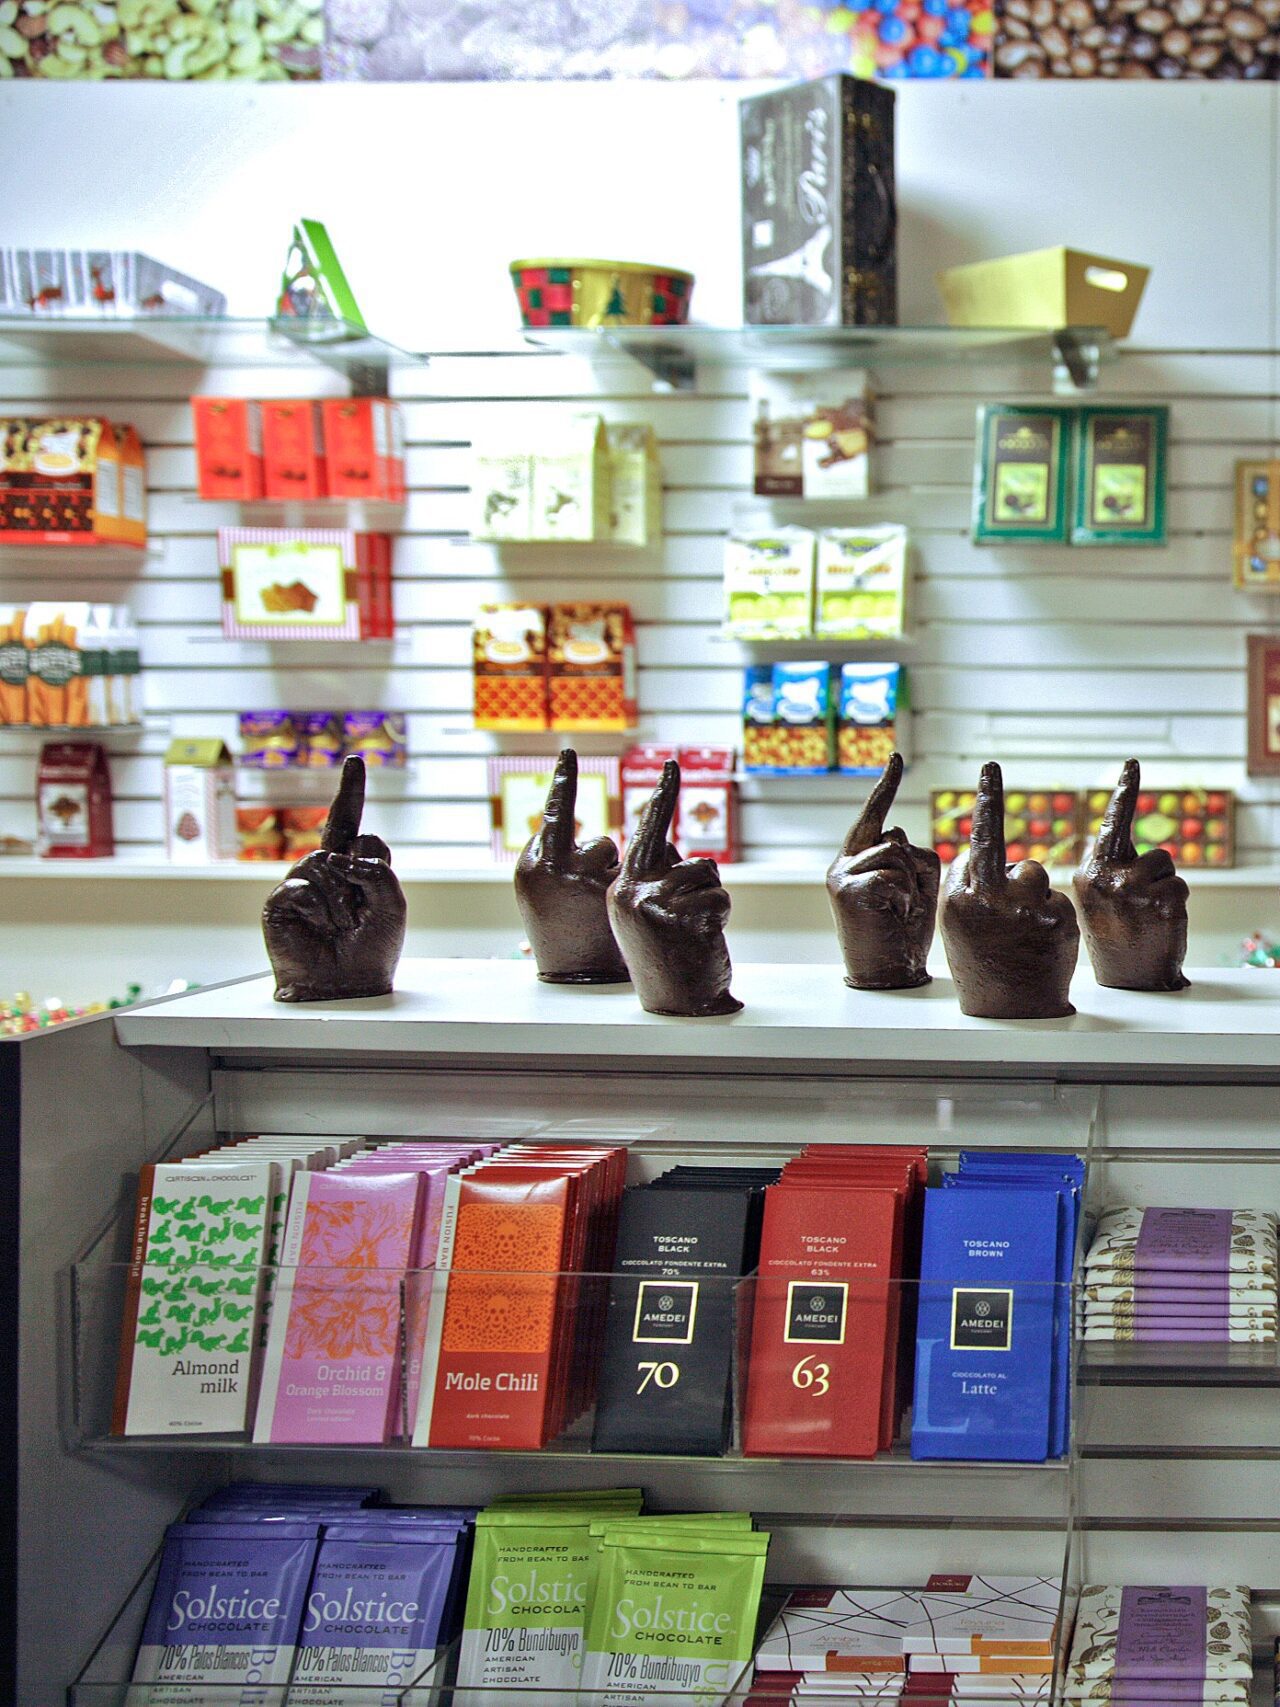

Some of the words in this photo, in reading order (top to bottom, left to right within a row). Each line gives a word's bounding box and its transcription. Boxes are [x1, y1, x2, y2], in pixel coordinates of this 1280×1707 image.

[140, 1196, 149, 1226] break
[444, 1205, 454, 1245] FUSION
[136, 1227, 146, 1242] the
[653, 1236, 698, 1244] TOSCANO
[801, 1236, 847, 1244] TOSCANO
[658, 1245, 690, 1253] BLACK
[806, 1245, 839, 1253] BLACK
[963, 1240, 1010, 1248] TOSCANO
[439, 1249, 449, 1269] BAR
[661, 1268, 681, 1276] 70%
[811, 1268, 830, 1276] 63%
[643, 1313, 686, 1323] AMEDEI
[795, 1314, 838, 1323] AMEDEI
[960, 1319, 1004, 1329] AMEDEI
[172, 1360, 239, 1375] Almond
[318, 1365, 371, 1381] Orchid
[376, 1366, 386, 1381] &
[445, 1372, 491, 1391] Mole
[495, 1373, 539, 1392] Chili
[636, 1361, 680, 1395] 70
[792, 1354, 830, 1396] 63
[952, 1371, 997, 1379] CIOCCOLATO
[200, 1378, 238, 1393] milk
[286, 1384, 330, 1398] Orange
[332, 1384, 384, 1396] Blossom
[962, 1381, 998, 1395] Latte
[626, 1569, 695, 1579] HANDCRAFTED
[167, 1584, 281, 1631] Solstice
[303, 1587, 419, 1632] Solstice
[610, 1595, 732, 1639] Solstice
[188, 1622, 270, 1632] CHOCOLATE
[324, 1625, 409, 1634] CHOCOLATE
[485, 1628, 515, 1652] 70%
[518, 1627, 579, 1656] Bundibugyo
[635, 1631, 723, 1645] CHOCOLATE
[159, 1645, 187, 1670] 70%
[296, 1646, 325, 1672] 70%
[326, 1647, 352, 1672] Palos
[351, 1648, 389, 1672] Blancos
[608, 1653, 637, 1678] 70%
[640, 1654, 701, 1688] Bundibugyo
[606, 1682, 656, 1690] AMERICAN
[603, 1694, 645, 1702] ARTISAN
